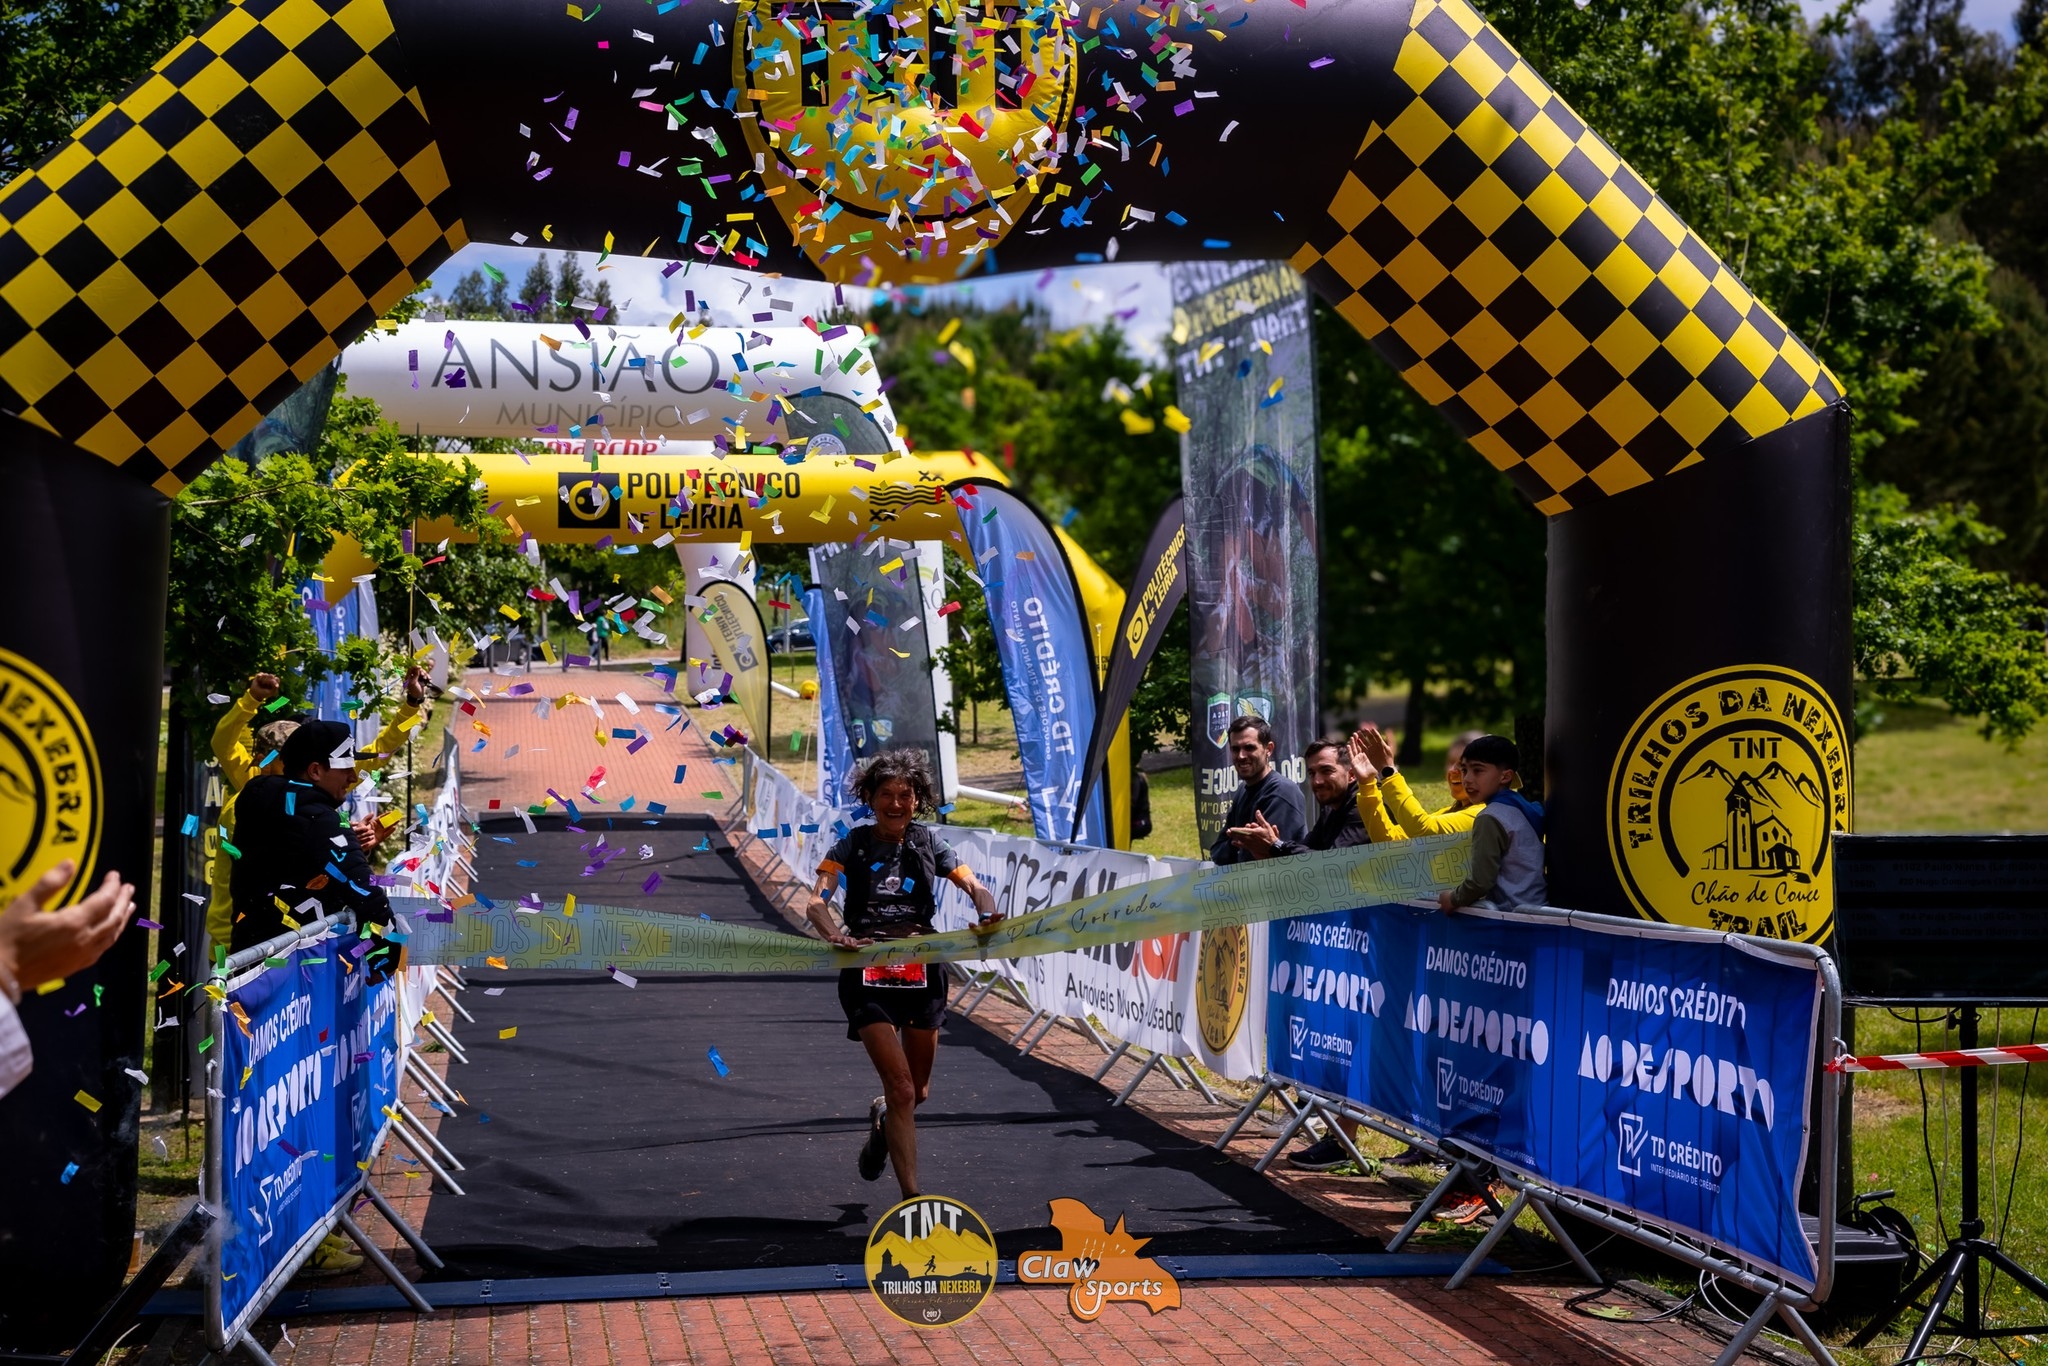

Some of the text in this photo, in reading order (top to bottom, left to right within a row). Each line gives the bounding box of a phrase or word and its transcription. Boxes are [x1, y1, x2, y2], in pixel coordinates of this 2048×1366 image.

[431, 334, 719, 394] ANSIÃO
[496, 396, 681, 428] MUNICÍPIO
[660, 503, 743, 529] LEIRIA
[1142, 523, 1185, 610] POLITÉCNIC
[1154, 563, 1178, 609] LEIRIA
[1627, 702, 1709, 848] TRILHOS
[1718, 687, 1772, 716] DA
[1728, 737, 1782, 759] TNT
[1193, 867, 1319, 916] TRILHOS
[1323, 861, 1368, 898] DA
[1691, 880, 1820, 905] Chão de Couce
[1071, 893, 1162, 933] Corrida
[540, 917, 582, 955] DA
[592, 919, 738, 959] NEXEBRA
[1286, 920, 1369, 954] DAMOS CRÉDITO
[1426, 945, 1527, 989] DAMOS CRÉDITO
[1292, 963, 1385, 1018] DESPORTO
[1606, 978, 1668, 1017] DAMOS
[249, 1010, 278, 1067] DAMOS
[1310, 1031, 1352, 1056] TD CRÉDITO
[1404, 991, 1549, 1066] AO DESPORTO
[1458, 1075, 1504, 1105] TD CRÉDITO
[1578, 1031, 1774, 1133] AO DESPORTO
[1651, 1136, 1722, 1177] TD CRÉDITO
[1690, 1175, 1698, 1186] DE
